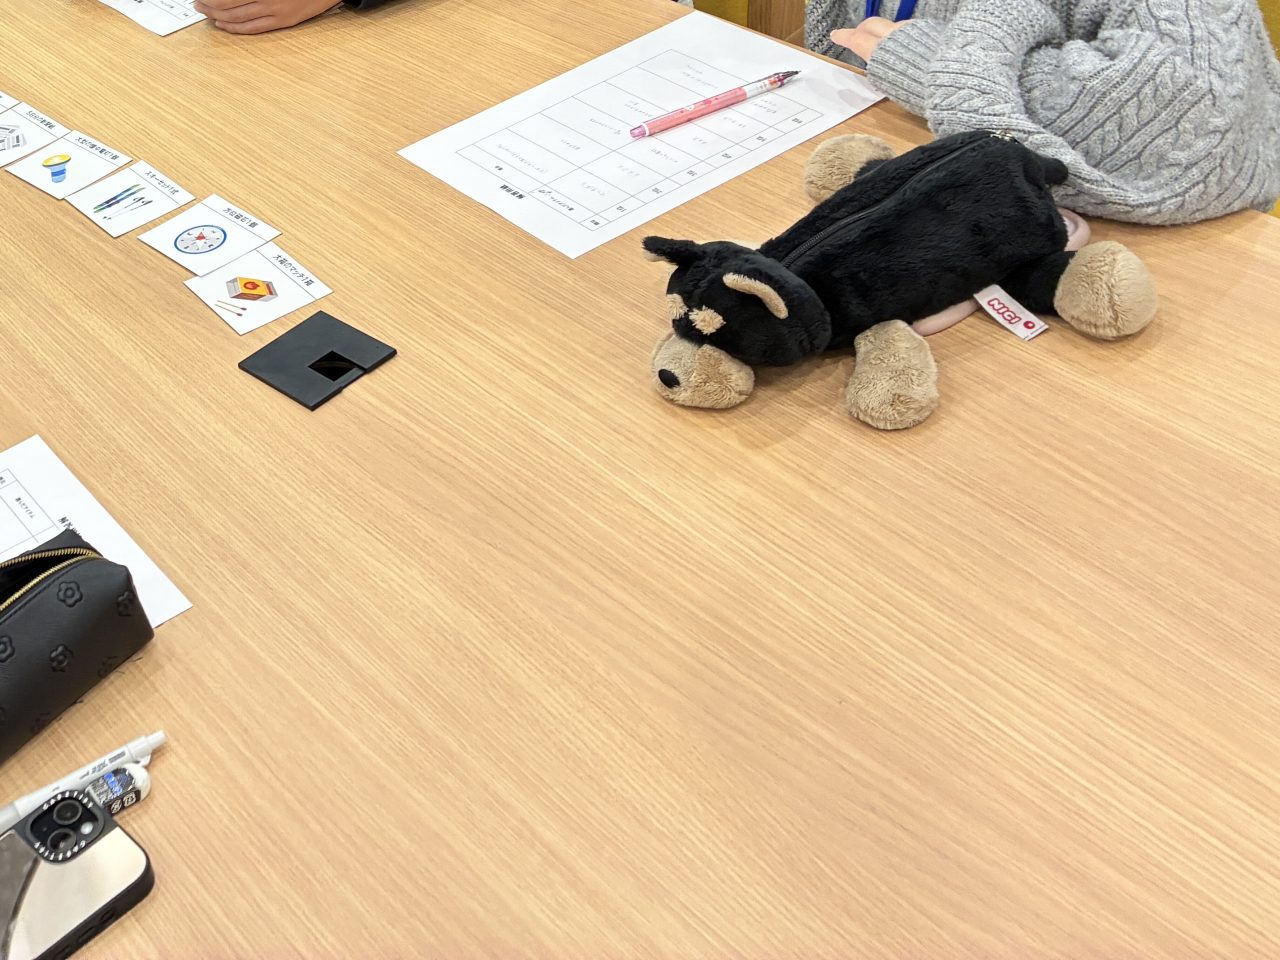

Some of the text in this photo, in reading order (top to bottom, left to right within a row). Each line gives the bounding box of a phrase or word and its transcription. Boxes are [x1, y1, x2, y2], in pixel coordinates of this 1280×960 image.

[273, 253, 315, 288] 大箱のマッチ1箱
